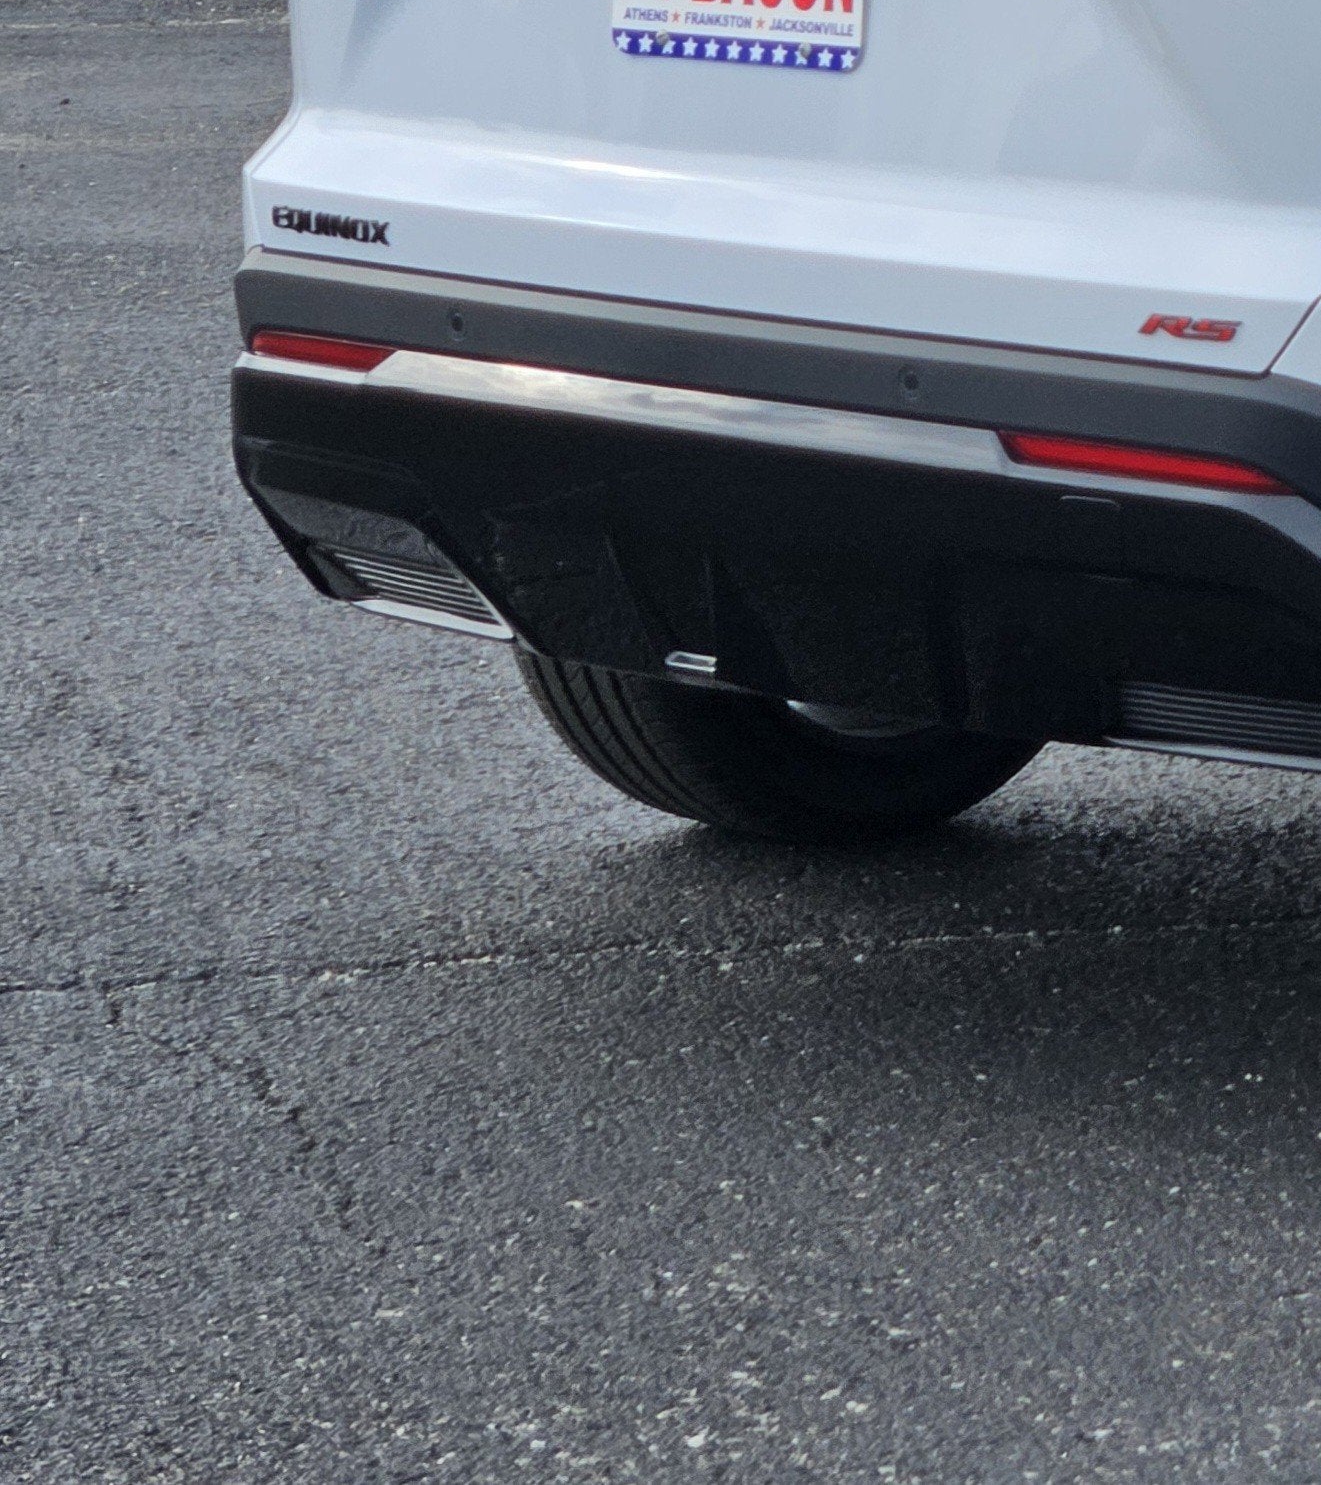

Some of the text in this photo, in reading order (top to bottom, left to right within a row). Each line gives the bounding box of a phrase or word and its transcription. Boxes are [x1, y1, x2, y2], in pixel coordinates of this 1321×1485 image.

[623, 6, 855, 37] ATHENS FRANKSTON JACKSONVILLE
[271, 204, 390, 247] EQUINOX
[1138, 313, 1243, 341] RS
